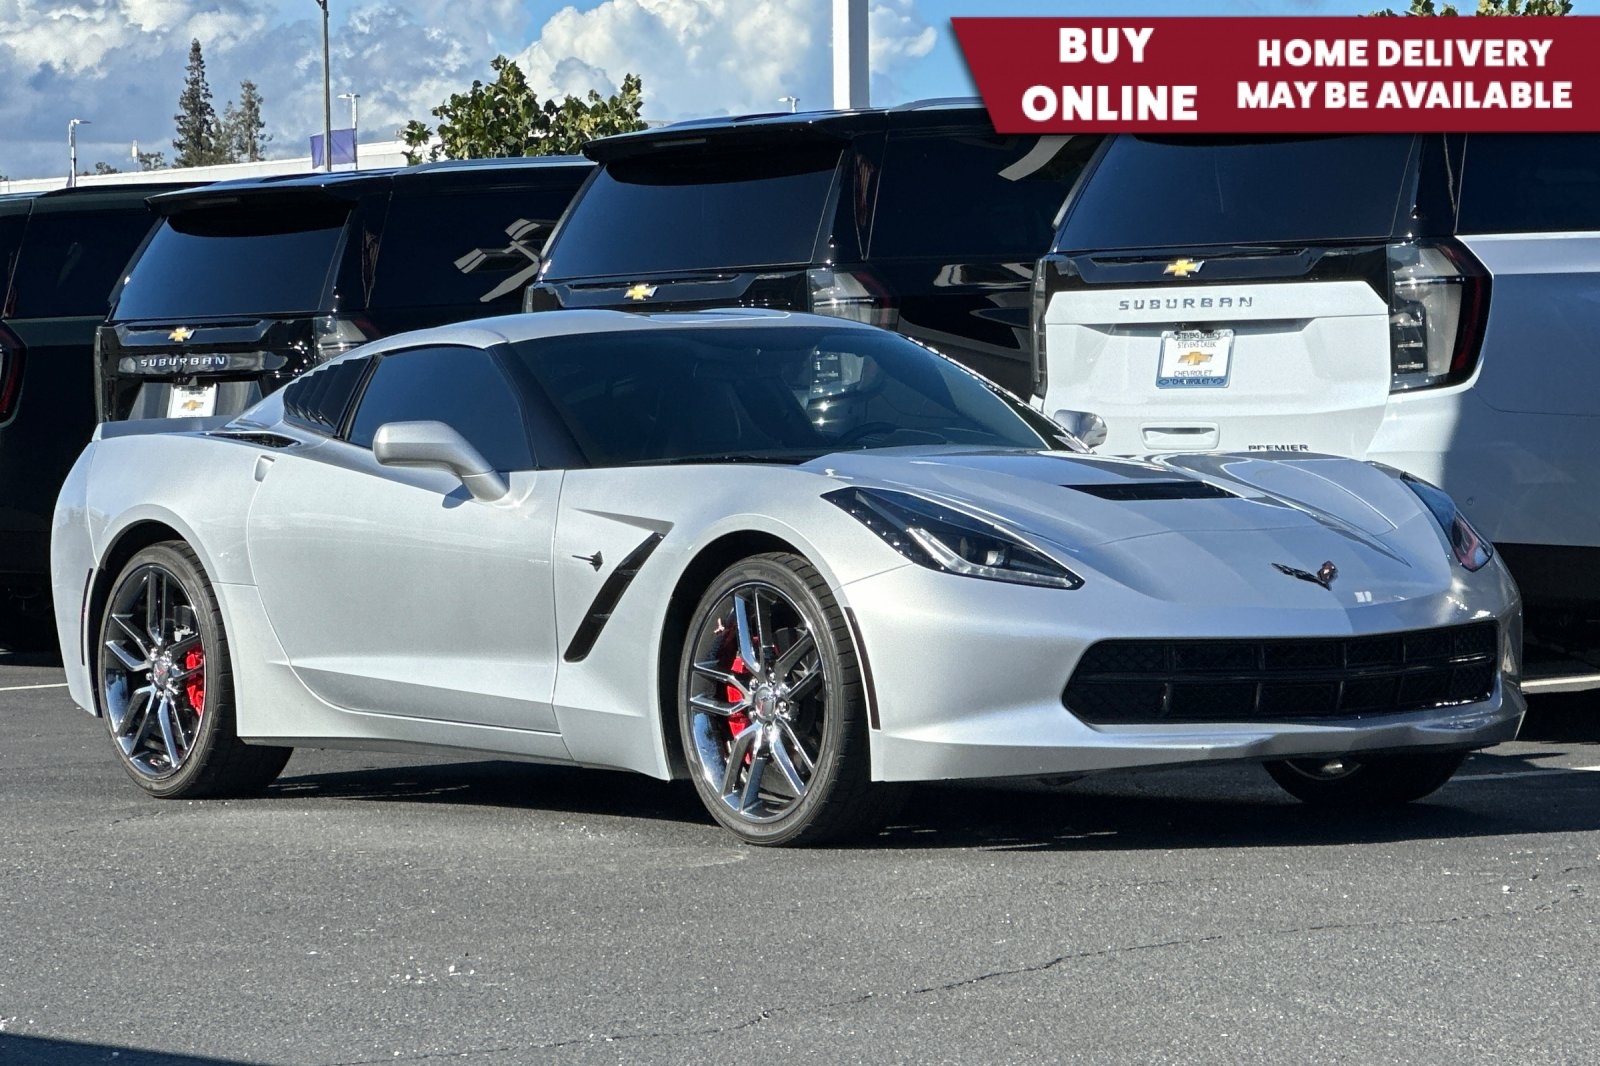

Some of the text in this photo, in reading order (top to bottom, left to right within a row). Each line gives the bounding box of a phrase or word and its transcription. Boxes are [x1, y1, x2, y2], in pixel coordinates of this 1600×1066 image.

[1118, 296, 1253, 310] SUBURBAN
[140, 356, 226, 367] SUBURBAN
[1248, 444, 1309, 452] PREMIER
